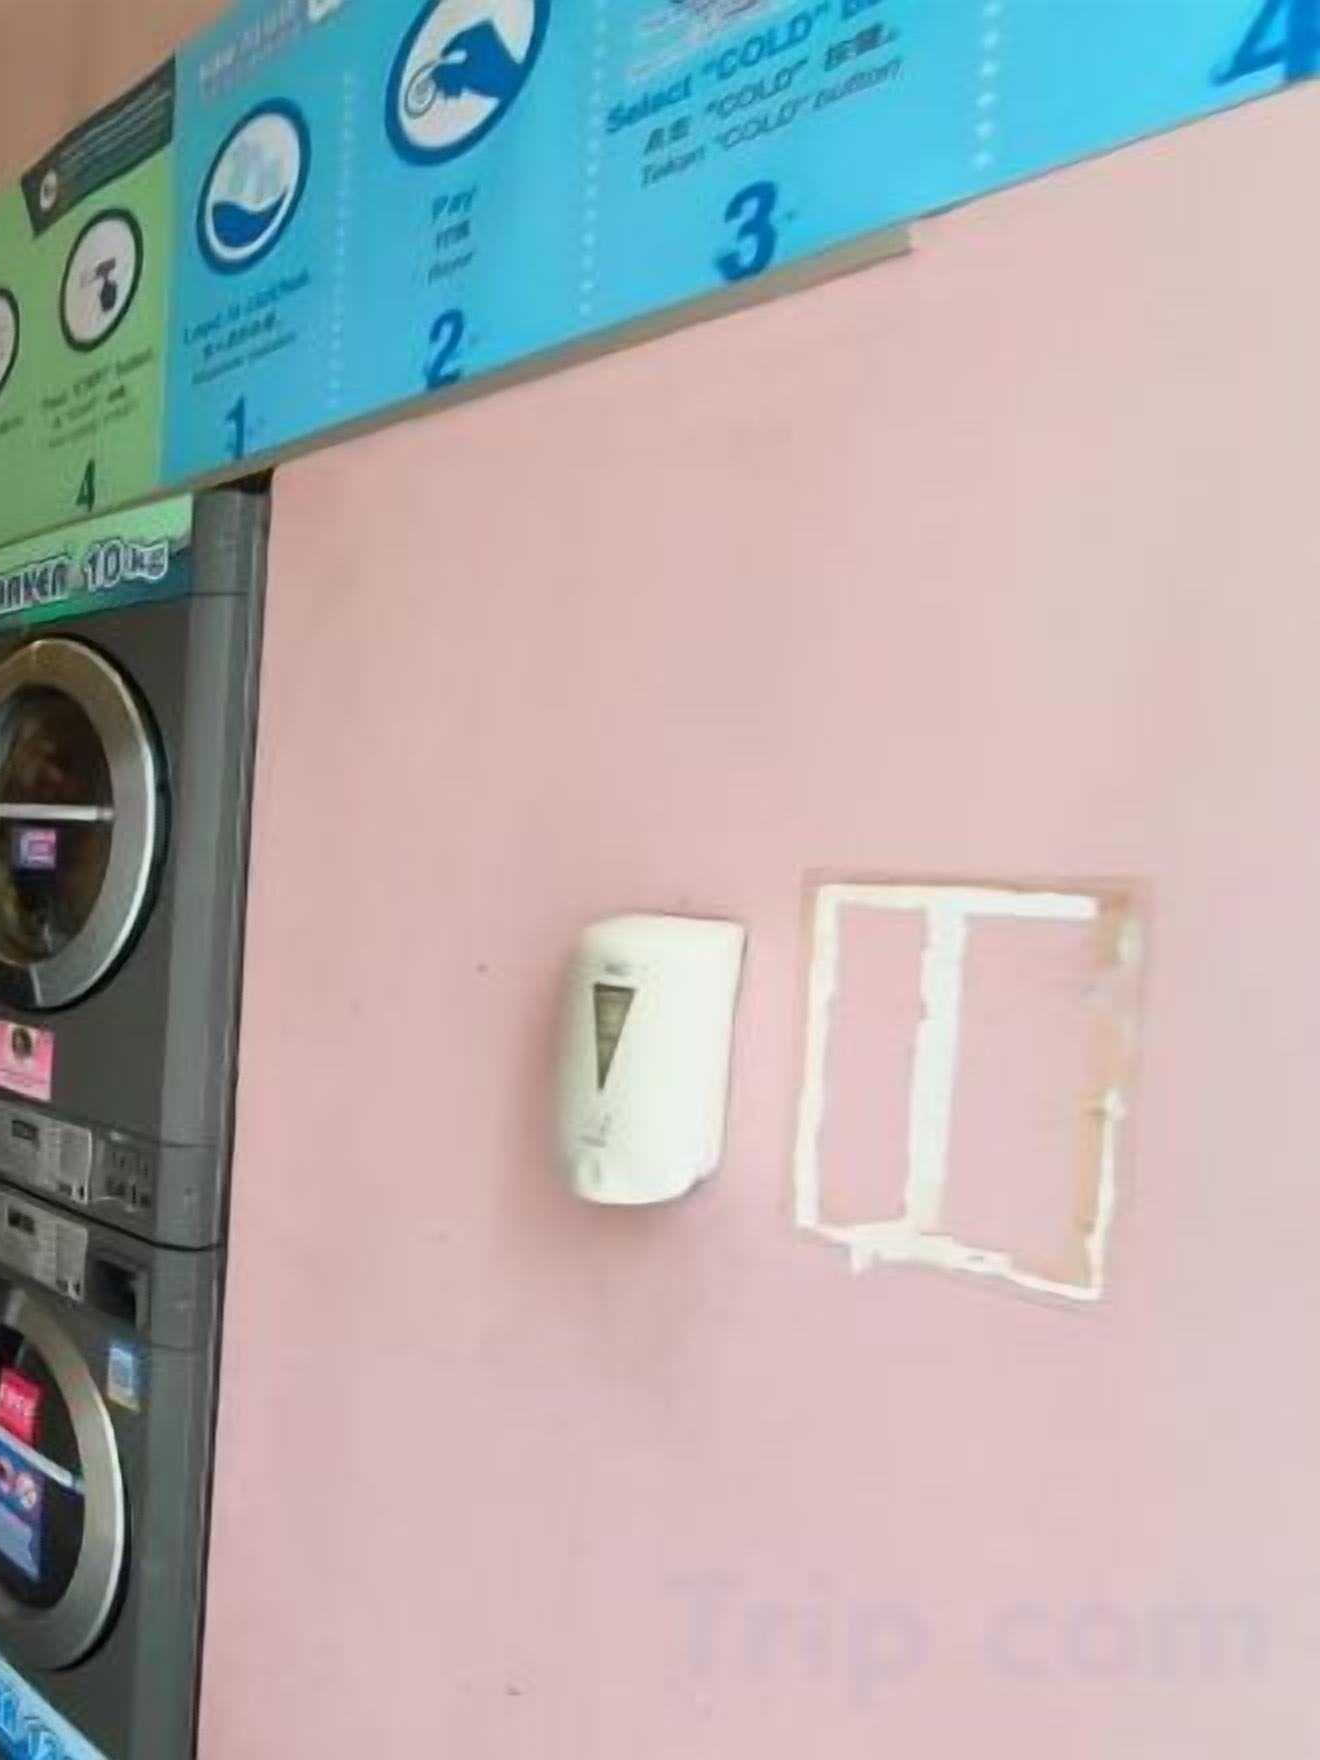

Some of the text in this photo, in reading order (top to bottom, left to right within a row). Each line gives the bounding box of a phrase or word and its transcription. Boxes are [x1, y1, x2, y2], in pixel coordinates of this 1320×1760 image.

[604, 72, 693, 134] Select
[714, 180, 778, 282] 3
[425, 308, 465, 391] 2
[225, 396, 246, 461] 1
[76, 458, 96, 511] 4
